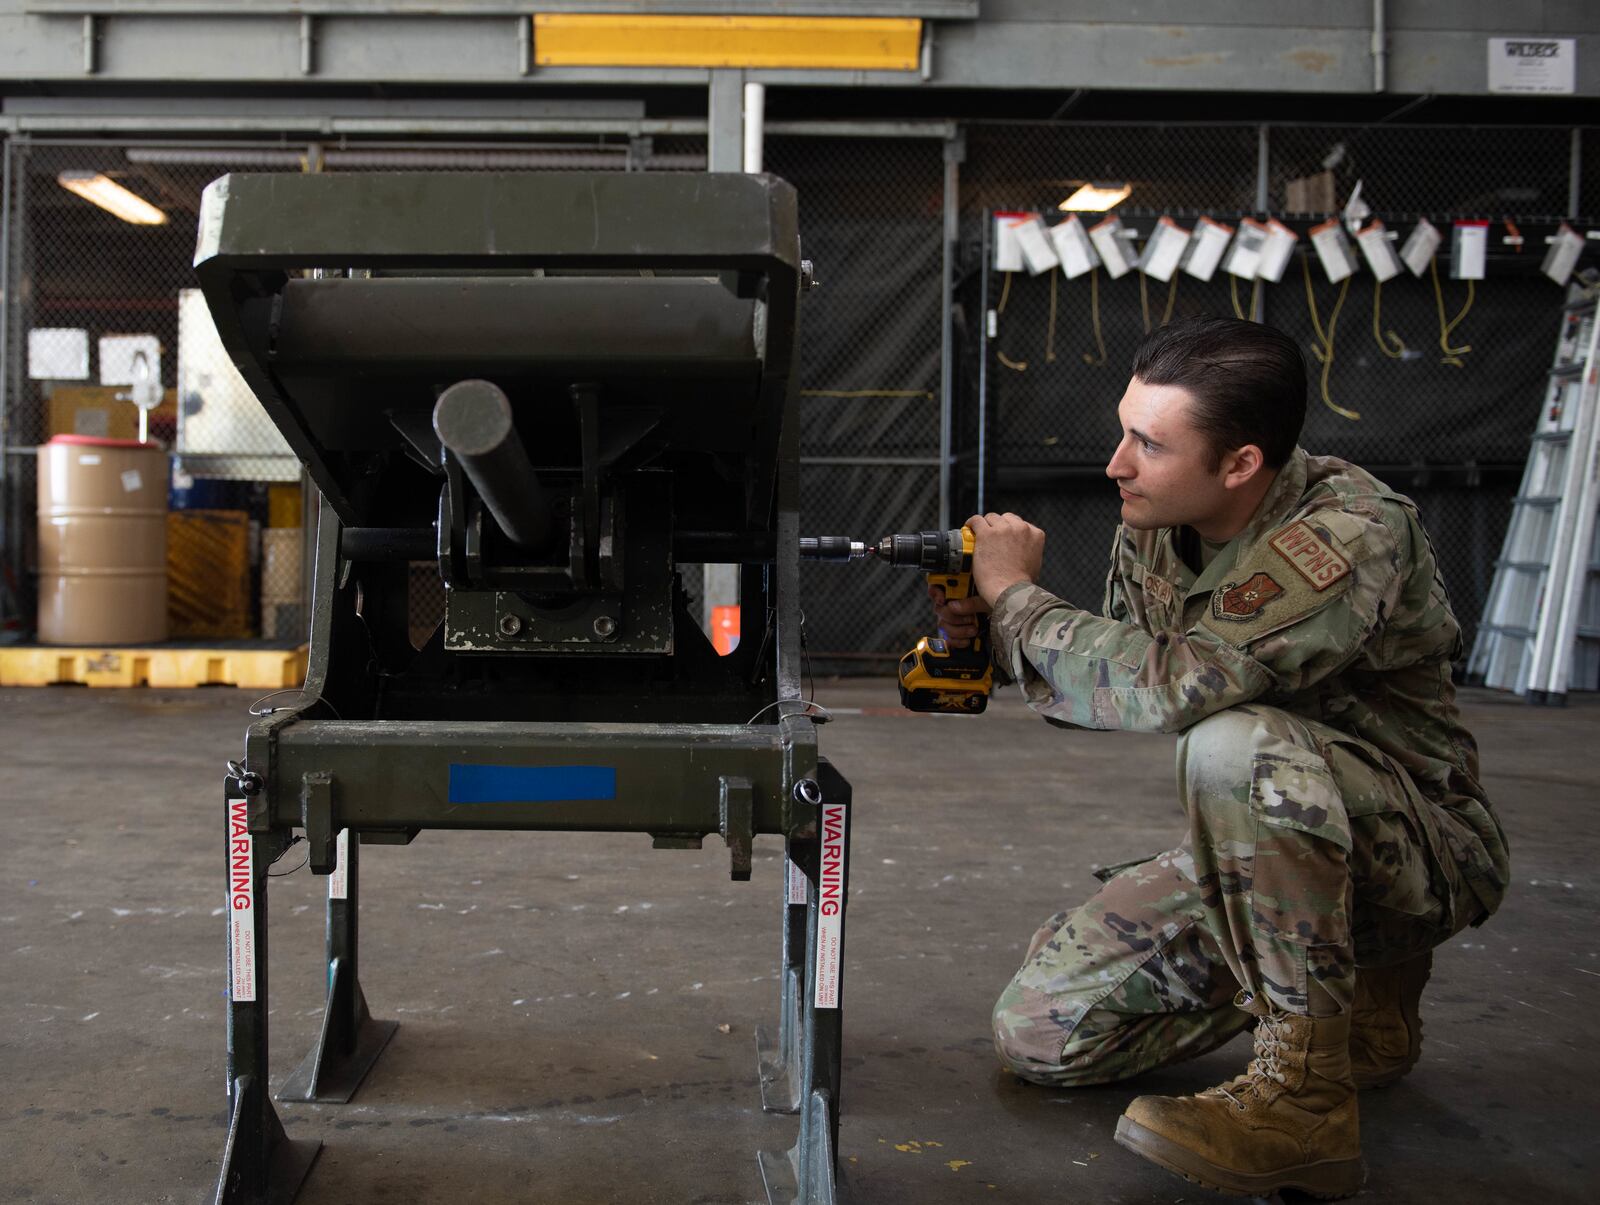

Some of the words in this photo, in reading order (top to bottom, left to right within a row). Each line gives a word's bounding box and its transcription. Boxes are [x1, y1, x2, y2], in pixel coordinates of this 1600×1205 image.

[1280, 526, 1341, 581] WPNS
[232, 802, 250, 910] WARNING
[821, 807, 842, 916] WARNING
[245, 930, 250, 940] DO
[831, 937, 836, 946] DO
[236, 976, 241, 984] ON
[819, 983, 824, 991] ON
